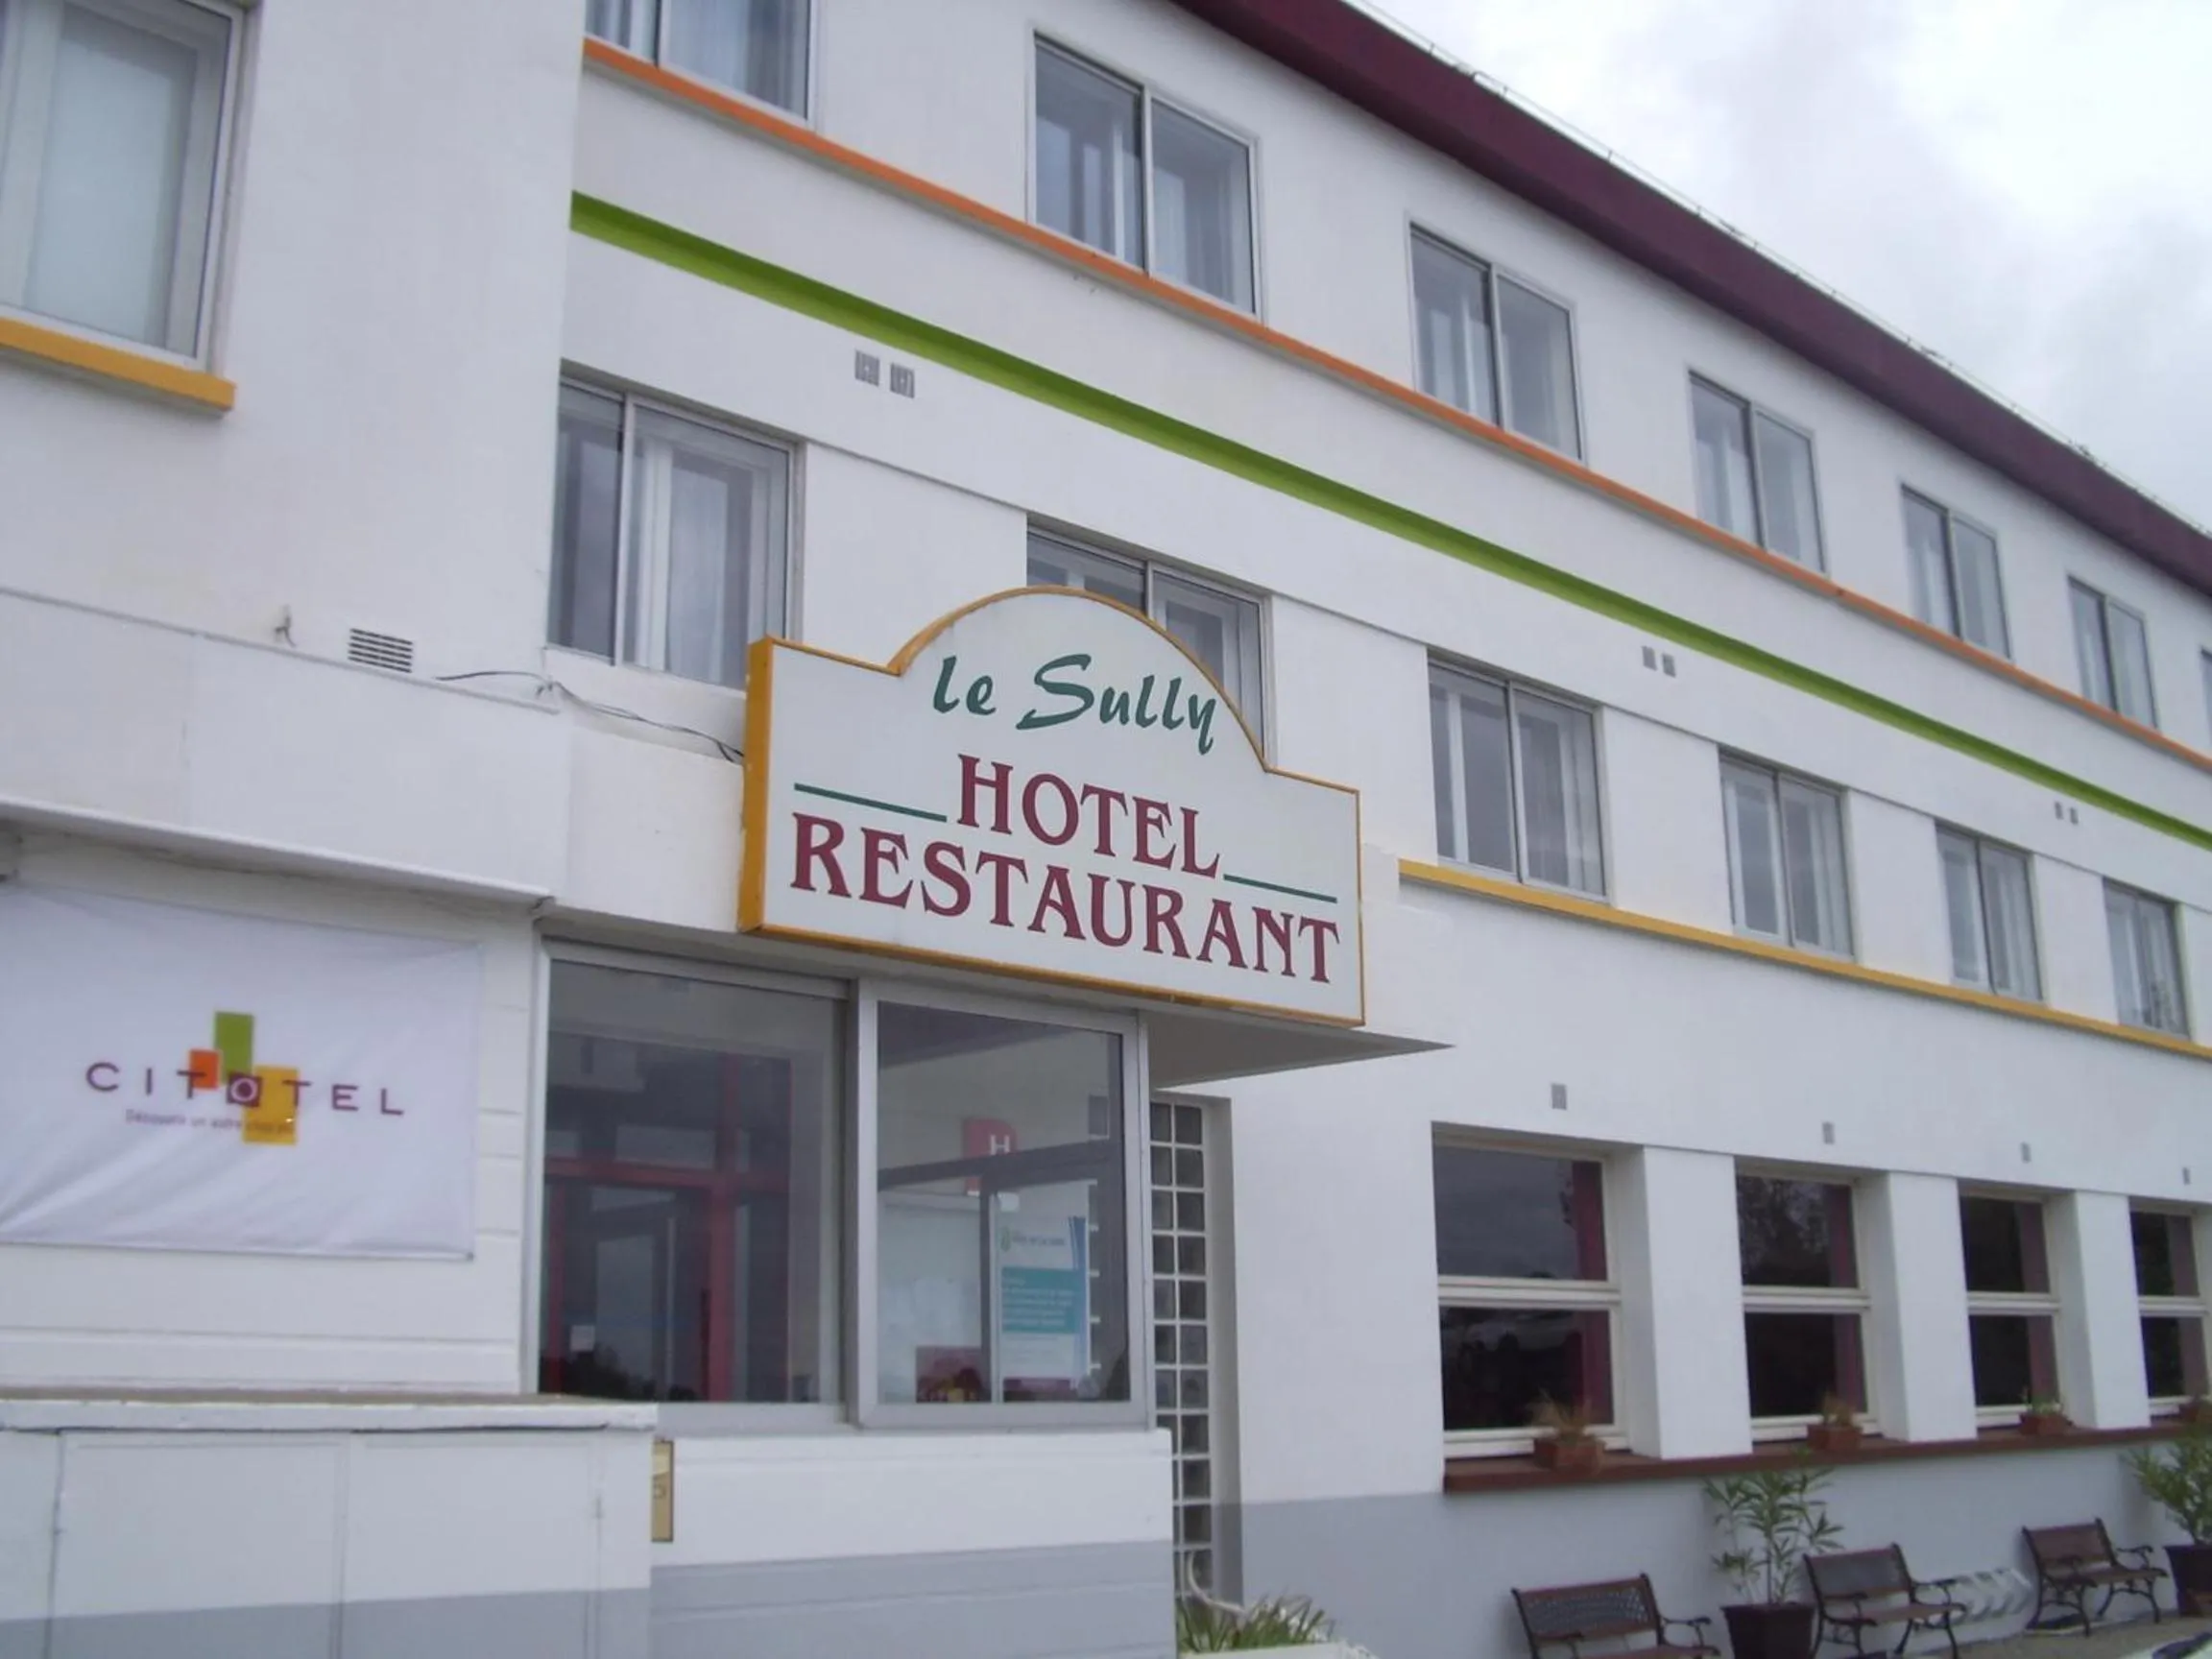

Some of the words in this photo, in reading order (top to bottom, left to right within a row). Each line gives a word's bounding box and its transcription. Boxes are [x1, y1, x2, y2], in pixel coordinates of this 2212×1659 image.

[1016, 654, 1216, 755] Sully
[957, 754, 1221, 878] HOTEL
[790, 812, 1340, 984] RESTAURANT
[85, 1062, 404, 1116] CITOTEL
